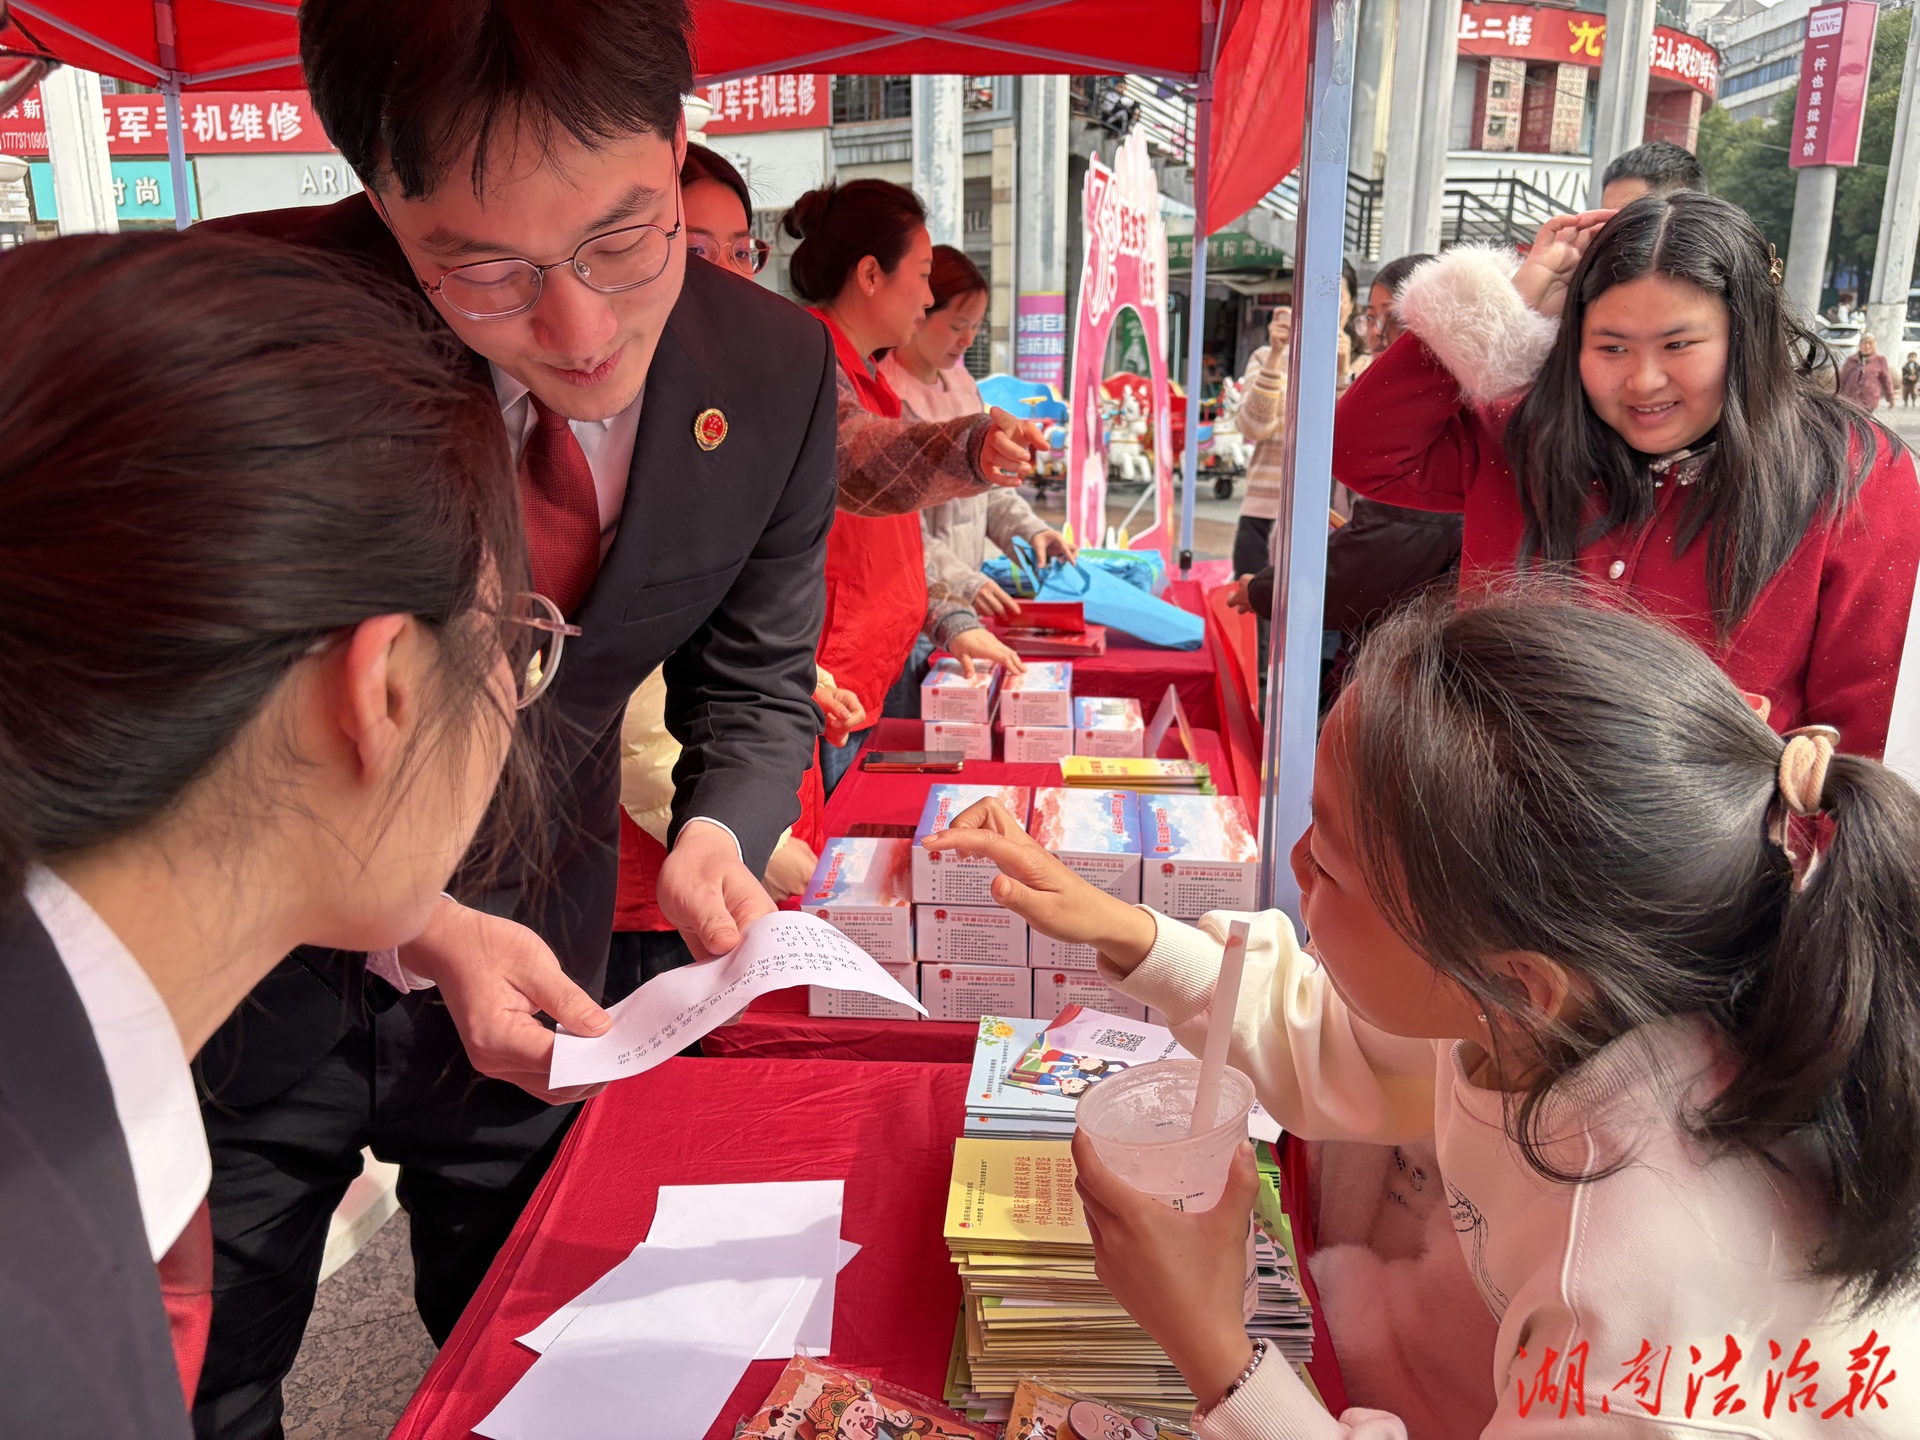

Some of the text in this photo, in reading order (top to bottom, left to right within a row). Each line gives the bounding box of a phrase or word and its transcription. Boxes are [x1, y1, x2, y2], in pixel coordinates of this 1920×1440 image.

[1458, 13, 1533, 46] 上二楼
[1803, 44, 1830, 156] 一件也是批发价
[1013, 1156, 1031, 1224] 中华人民共和国未成年人保护法
[1034, 1157, 1052, 1225] 中华人民共和国预防未成年人犯罪法
[1055, 1157, 1073, 1226] 中华人民共和国家庭教育促进法
